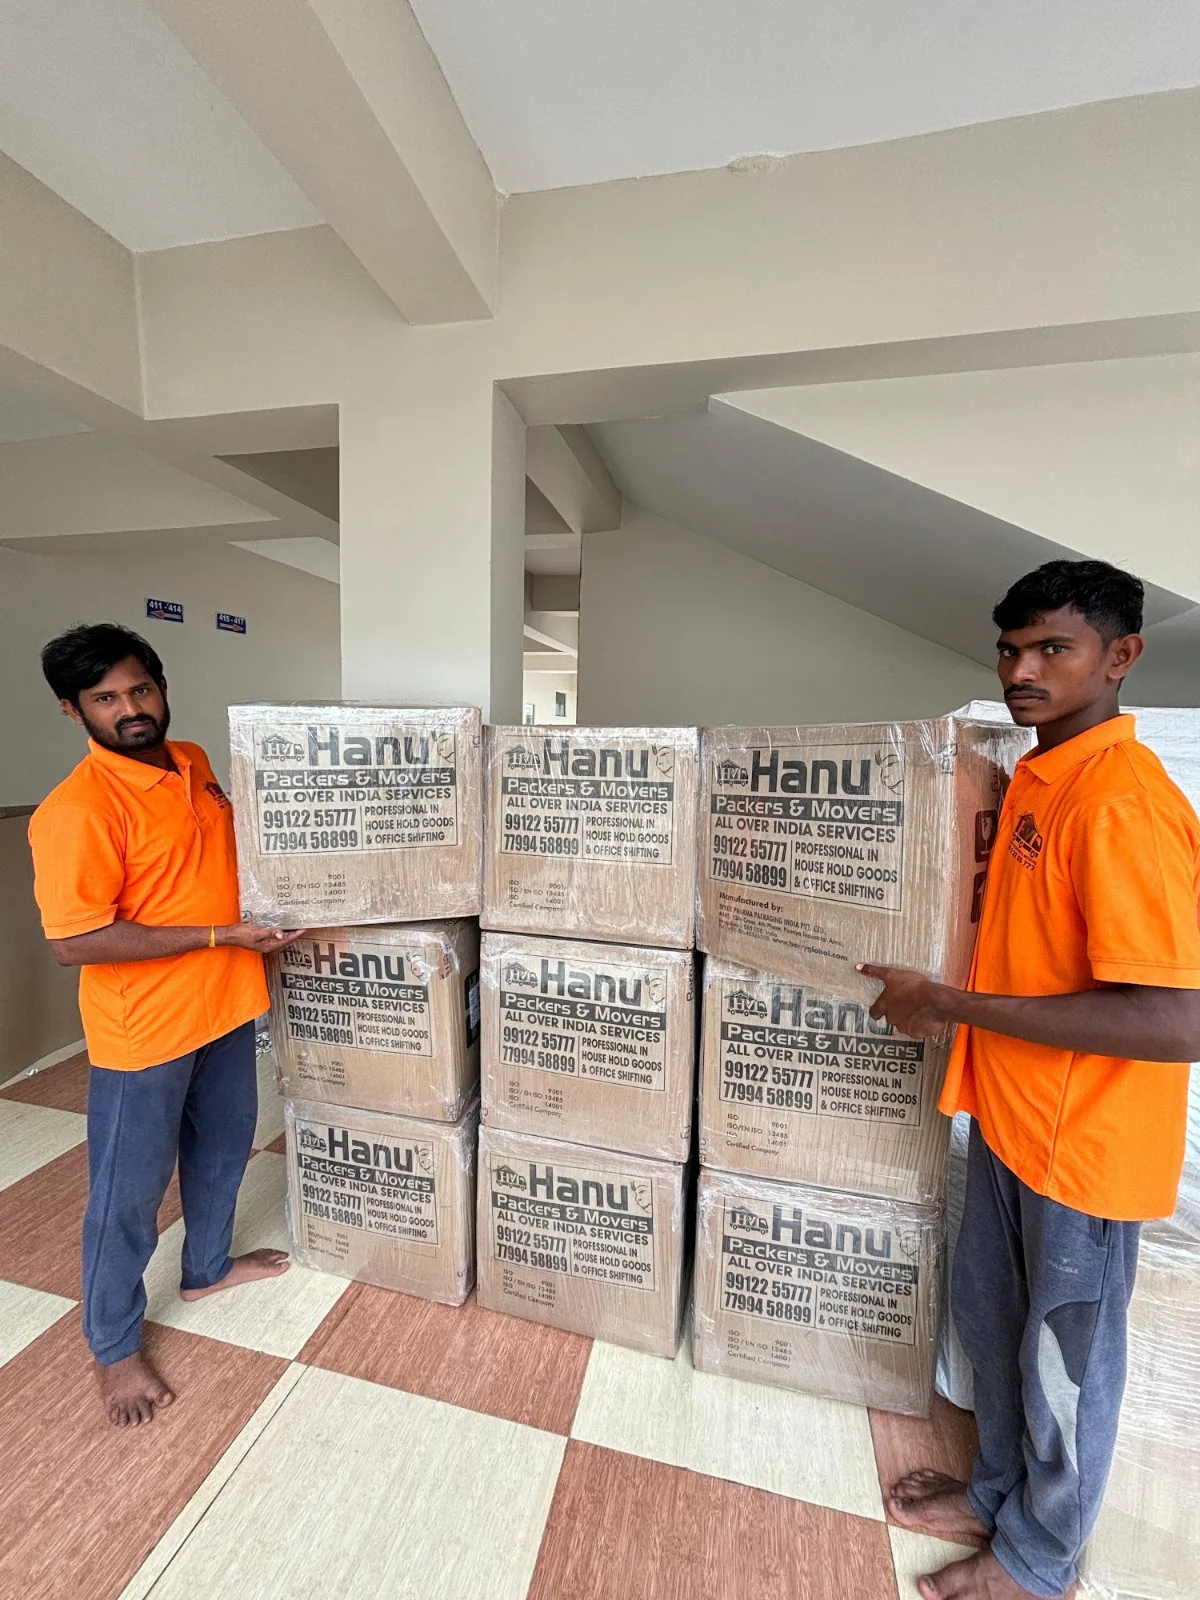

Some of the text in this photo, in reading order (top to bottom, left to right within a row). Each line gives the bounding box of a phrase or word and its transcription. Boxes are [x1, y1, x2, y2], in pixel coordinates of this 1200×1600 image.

[150, 601, 162, 610] 411
[168, 604, 181, 613] 414
[307, 728, 429, 766] Hanu
[543, 740, 648, 778] Hanu
[263, 770, 450, 787] Packers & Movers
[751, 748, 871, 796] Hanu
[264, 788, 450, 803] ALL OVER INDIA SERVICES
[508, 778, 668, 798] Packers & Movers
[263, 809, 357, 829] 99122 55777
[365, 806, 428, 816] PROFESSIONAL
[507, 797, 667, 814] ALL OVER INDIA SERVICES
[716, 796, 896, 822] Packers & Movers
[366, 817, 454, 830] HOUSE HOLD GOODS
[505, 813, 579, 834] 99122 55777
[716, 816, 895, 844] ALL OVER INDIA SERVICES
[264, 831, 358, 850] 77994 58899
[366, 832, 445, 844] & OFFICE SHIFTING
[504, 833, 579, 855] 77994 58899
[713, 834, 788, 863] 99122 55777
[712, 856, 787, 888] 77994 58899
[720, 892, 768, 909] Manufactured
[772, 902, 783, 913] by:
[312, 942, 405, 982] Hanu
[286, 975, 424, 1000] Packers & Movers
[540, 959, 641, 1007] Hanu
[288, 991, 424, 1014] ALL OVER INDIA SERVICES
[288, 1004, 352, 1026] 99122 55777
[506, 993, 660, 1028] Packers & Movers
[289, 1022, 353, 1044] 77994 58899
[504, 1025, 575, 1053] 99122 55777
[506, 1010, 660, 1044] ALL OVER INDIA SERVICES
[582, 1038, 648, 1055] PROFESSIONAL IN
[728, 1024, 917, 1059] Packers & Movers
[503, 1045, 575, 1073] 77994 58899
[582, 1051, 662, 1071] HOUSE HOLD GOODS
[727, 1044, 916, 1075] ALL OVER INDIA SERVICES
[582, 1065, 652, 1084] & OFFICE SHIFTING
[725, 1060, 813, 1088] 99122 55777
[724, 1081, 813, 1110] 77994 58899
[327, 1128, 413, 1173] Hanu
[302, 1156, 430, 1192] Packers & Movers
[303, 1171, 431, 1205] ALL OVER INDIA SERVICES
[529, 1164, 628, 1212] Hanu
[302, 1184, 362, 1210] 99122 55777
[303, 1200, 363, 1227] 77994 58899
[497, 1195, 648, 1232] Packers & Movers
[497, 1225, 566, 1253] 99122 55777
[498, 1211, 648, 1246] ALL OVER INDIA SERVICES
[771, 1206, 892, 1259] Hanu
[497, 1244, 567, 1272] 77994 58899
[730, 1238, 912, 1281] Packers & Movers
[726, 1271, 812, 1303] 99122 55777
[729, 1256, 911, 1297] ALL OVER INDIA SERVICES
[725, 1292, 811, 1324] 77994 58899
[820, 1288, 897, 1308] PROFESSIONAL IN
[819, 1316, 901, 1337] & OFFICE SHIFTING
[820, 1302, 912, 1325] HOUSE HOLD GOODS
